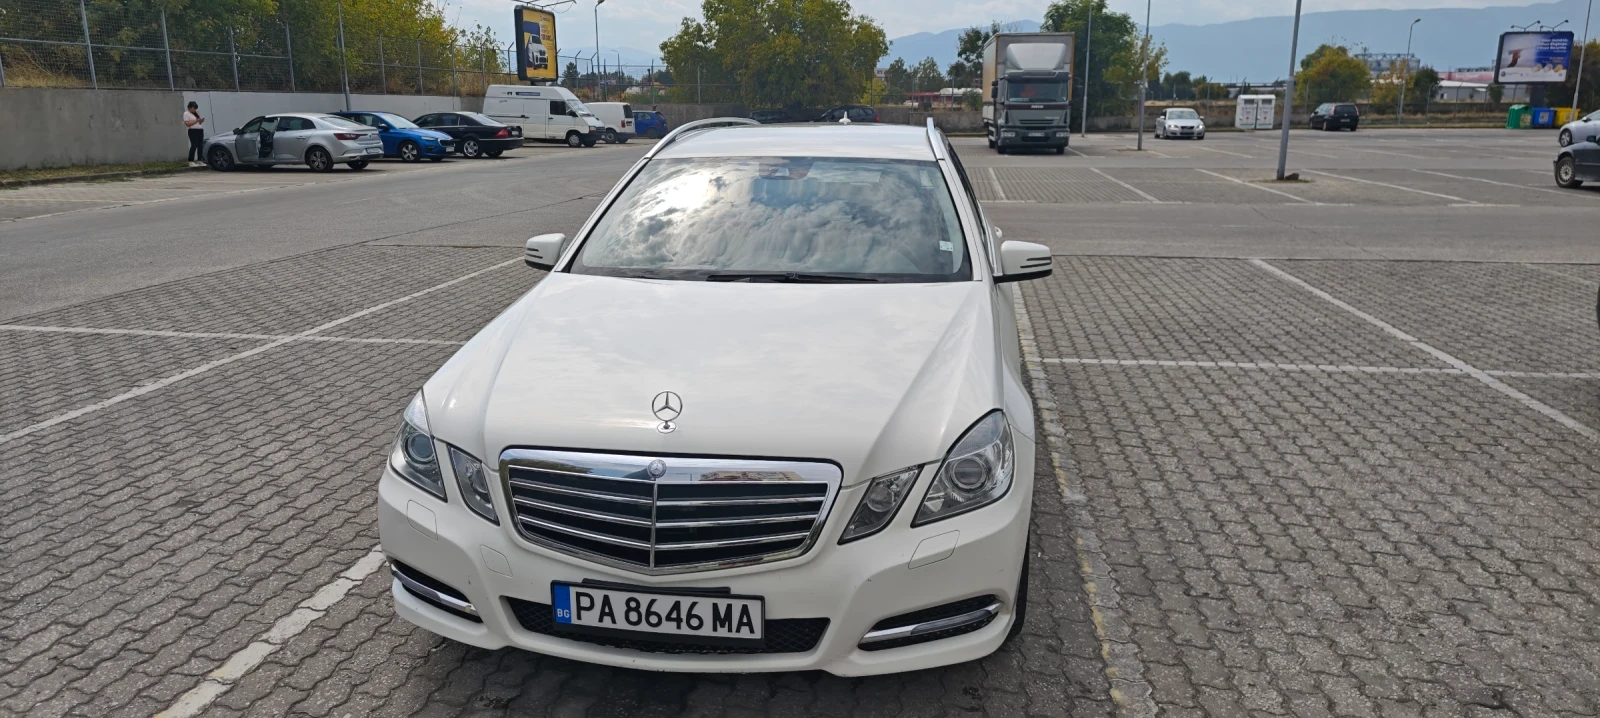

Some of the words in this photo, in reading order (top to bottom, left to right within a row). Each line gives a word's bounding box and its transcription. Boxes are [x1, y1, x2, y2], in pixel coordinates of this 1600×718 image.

[556, 608, 570, 618] BG
[575, 591, 617, 624] PA
[624, 596, 704, 631] 8646
[712, 602, 755, 634] MA
